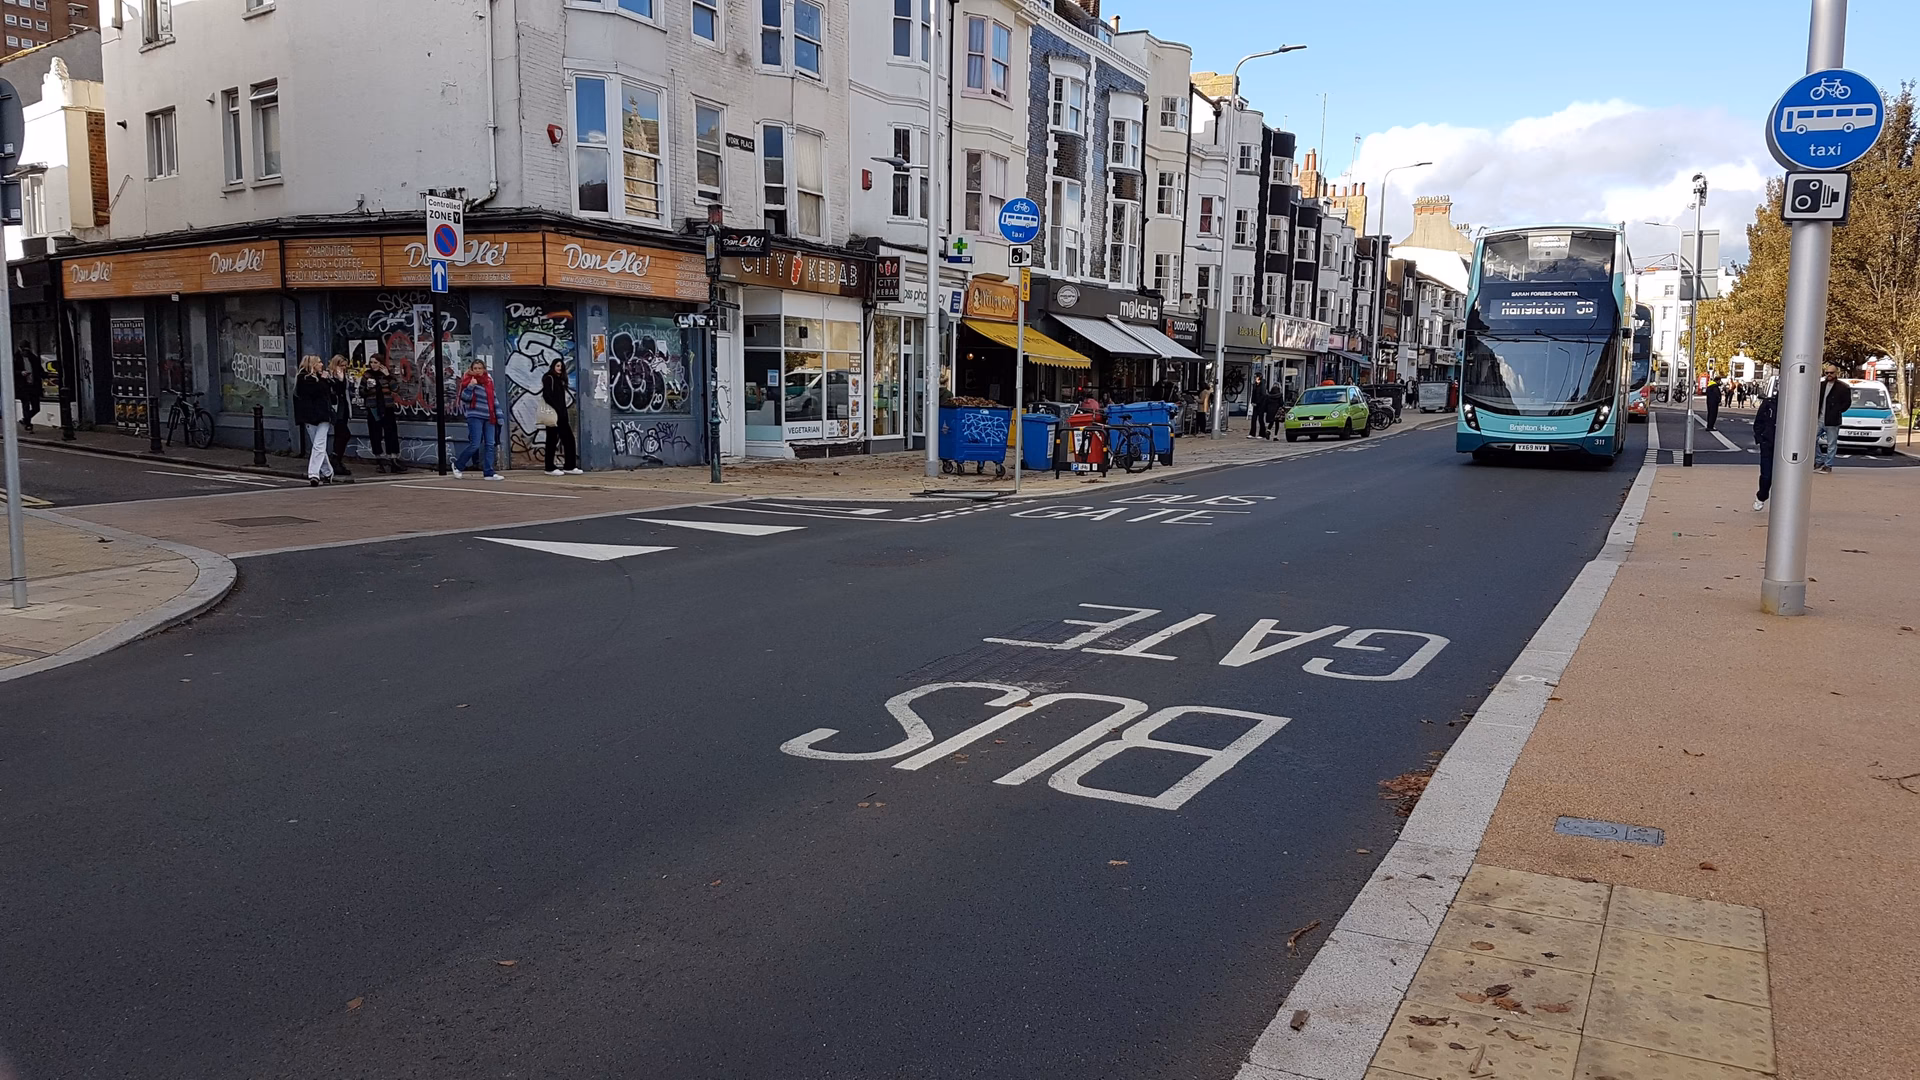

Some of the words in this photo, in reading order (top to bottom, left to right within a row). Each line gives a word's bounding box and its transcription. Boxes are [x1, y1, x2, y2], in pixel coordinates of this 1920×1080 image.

[740, 139, 754, 150] PLACE
[1809, 142, 1842, 156] taxi
[428, 198, 461, 211] Controlled
[429, 210, 452, 222] ZONE
[1011, 230, 1025, 239] taxi
[722, 237, 738, 247] Don
[208, 252, 232, 275] Don
[232, 247, 266, 273] Olé!
[299, 258, 326, 269] SALADS
[333, 257, 361, 268] COFFEE
[563, 243, 601, 269] Don
[601, 249, 650, 277] Olé!
[287, 270, 307, 281] READY
[308, 270, 329, 280] MEALS
[333, 269, 375, 281] SANDWICHES
[741, 251, 786, 277] CITY
[808, 258, 858, 288] KEBAB
[878, 279, 898, 287] CITY
[877, 288, 899, 296] KEBAB
[914, 288, 947, 306] phacy
[1119, 298, 1159, 320] moksha
[1174, 321, 1186, 331] DODO
[1186, 321, 1198, 332] PIZZA
[262, 339, 282, 350] BREAD
[265, 362, 281, 371] MEAT
[788, 426, 820, 435] VEGETARIAN
[1509, 424, 1537, 433] Brighton
[1594, 438, 1605, 446] 311
[1110, 494, 1277, 506] BUS
[1010, 505, 1251, 525] GATE
[983, 603, 1450, 681] GATE
[779, 681, 1292, 810] BUS
